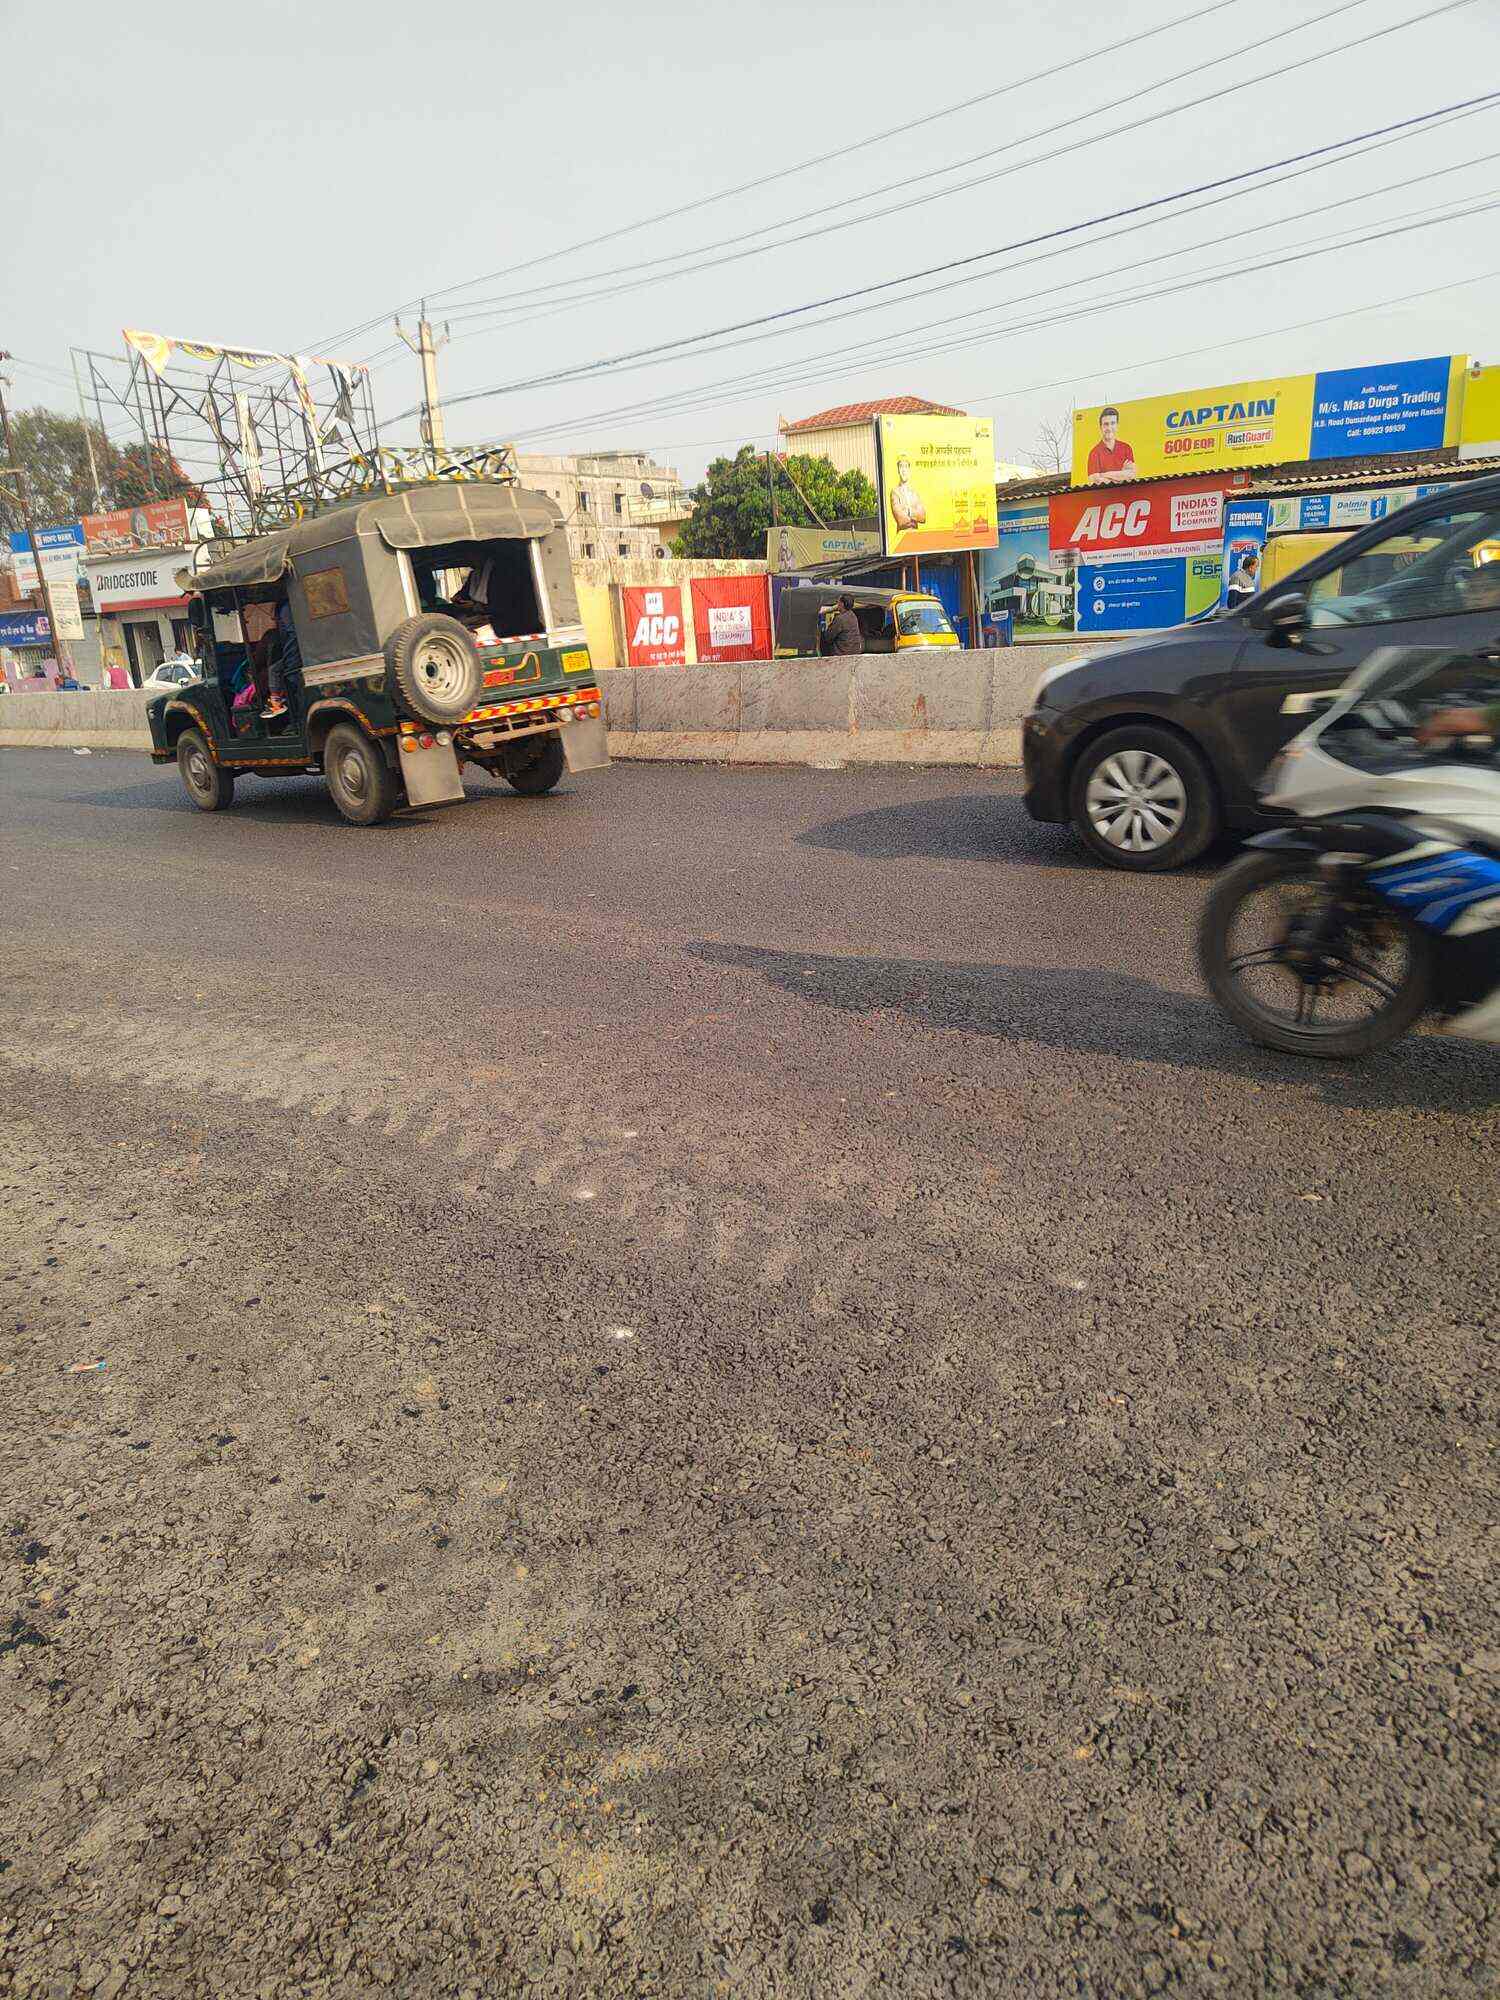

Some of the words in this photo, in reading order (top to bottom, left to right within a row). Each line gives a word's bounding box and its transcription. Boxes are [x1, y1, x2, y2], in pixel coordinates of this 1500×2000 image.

[1319, 401, 1340, 414] M/s.
[1343, 399, 1366, 411] Maa
[1368, 396, 1399, 409] Durga
[1401, 391, 1441, 404] Trading
[1166, 398, 1276, 428] CAPTAIN
[1328, 418, 1344, 427] Road
[1164, 437, 1193, 454] 600
[1193, 437, 1215, 450] EQR
[1177, 496, 1218, 510] INDIA'S
[1336, 500, 1368, 510] Dalmia
[1069, 500, 1151, 543] ACC
[1181, 517, 1217, 526] COMPANY
[1190, 509, 1217, 517] CEMENT
[97, 570, 159, 591] BRIDGESTONE
[632, 616, 680, 647] ACC
